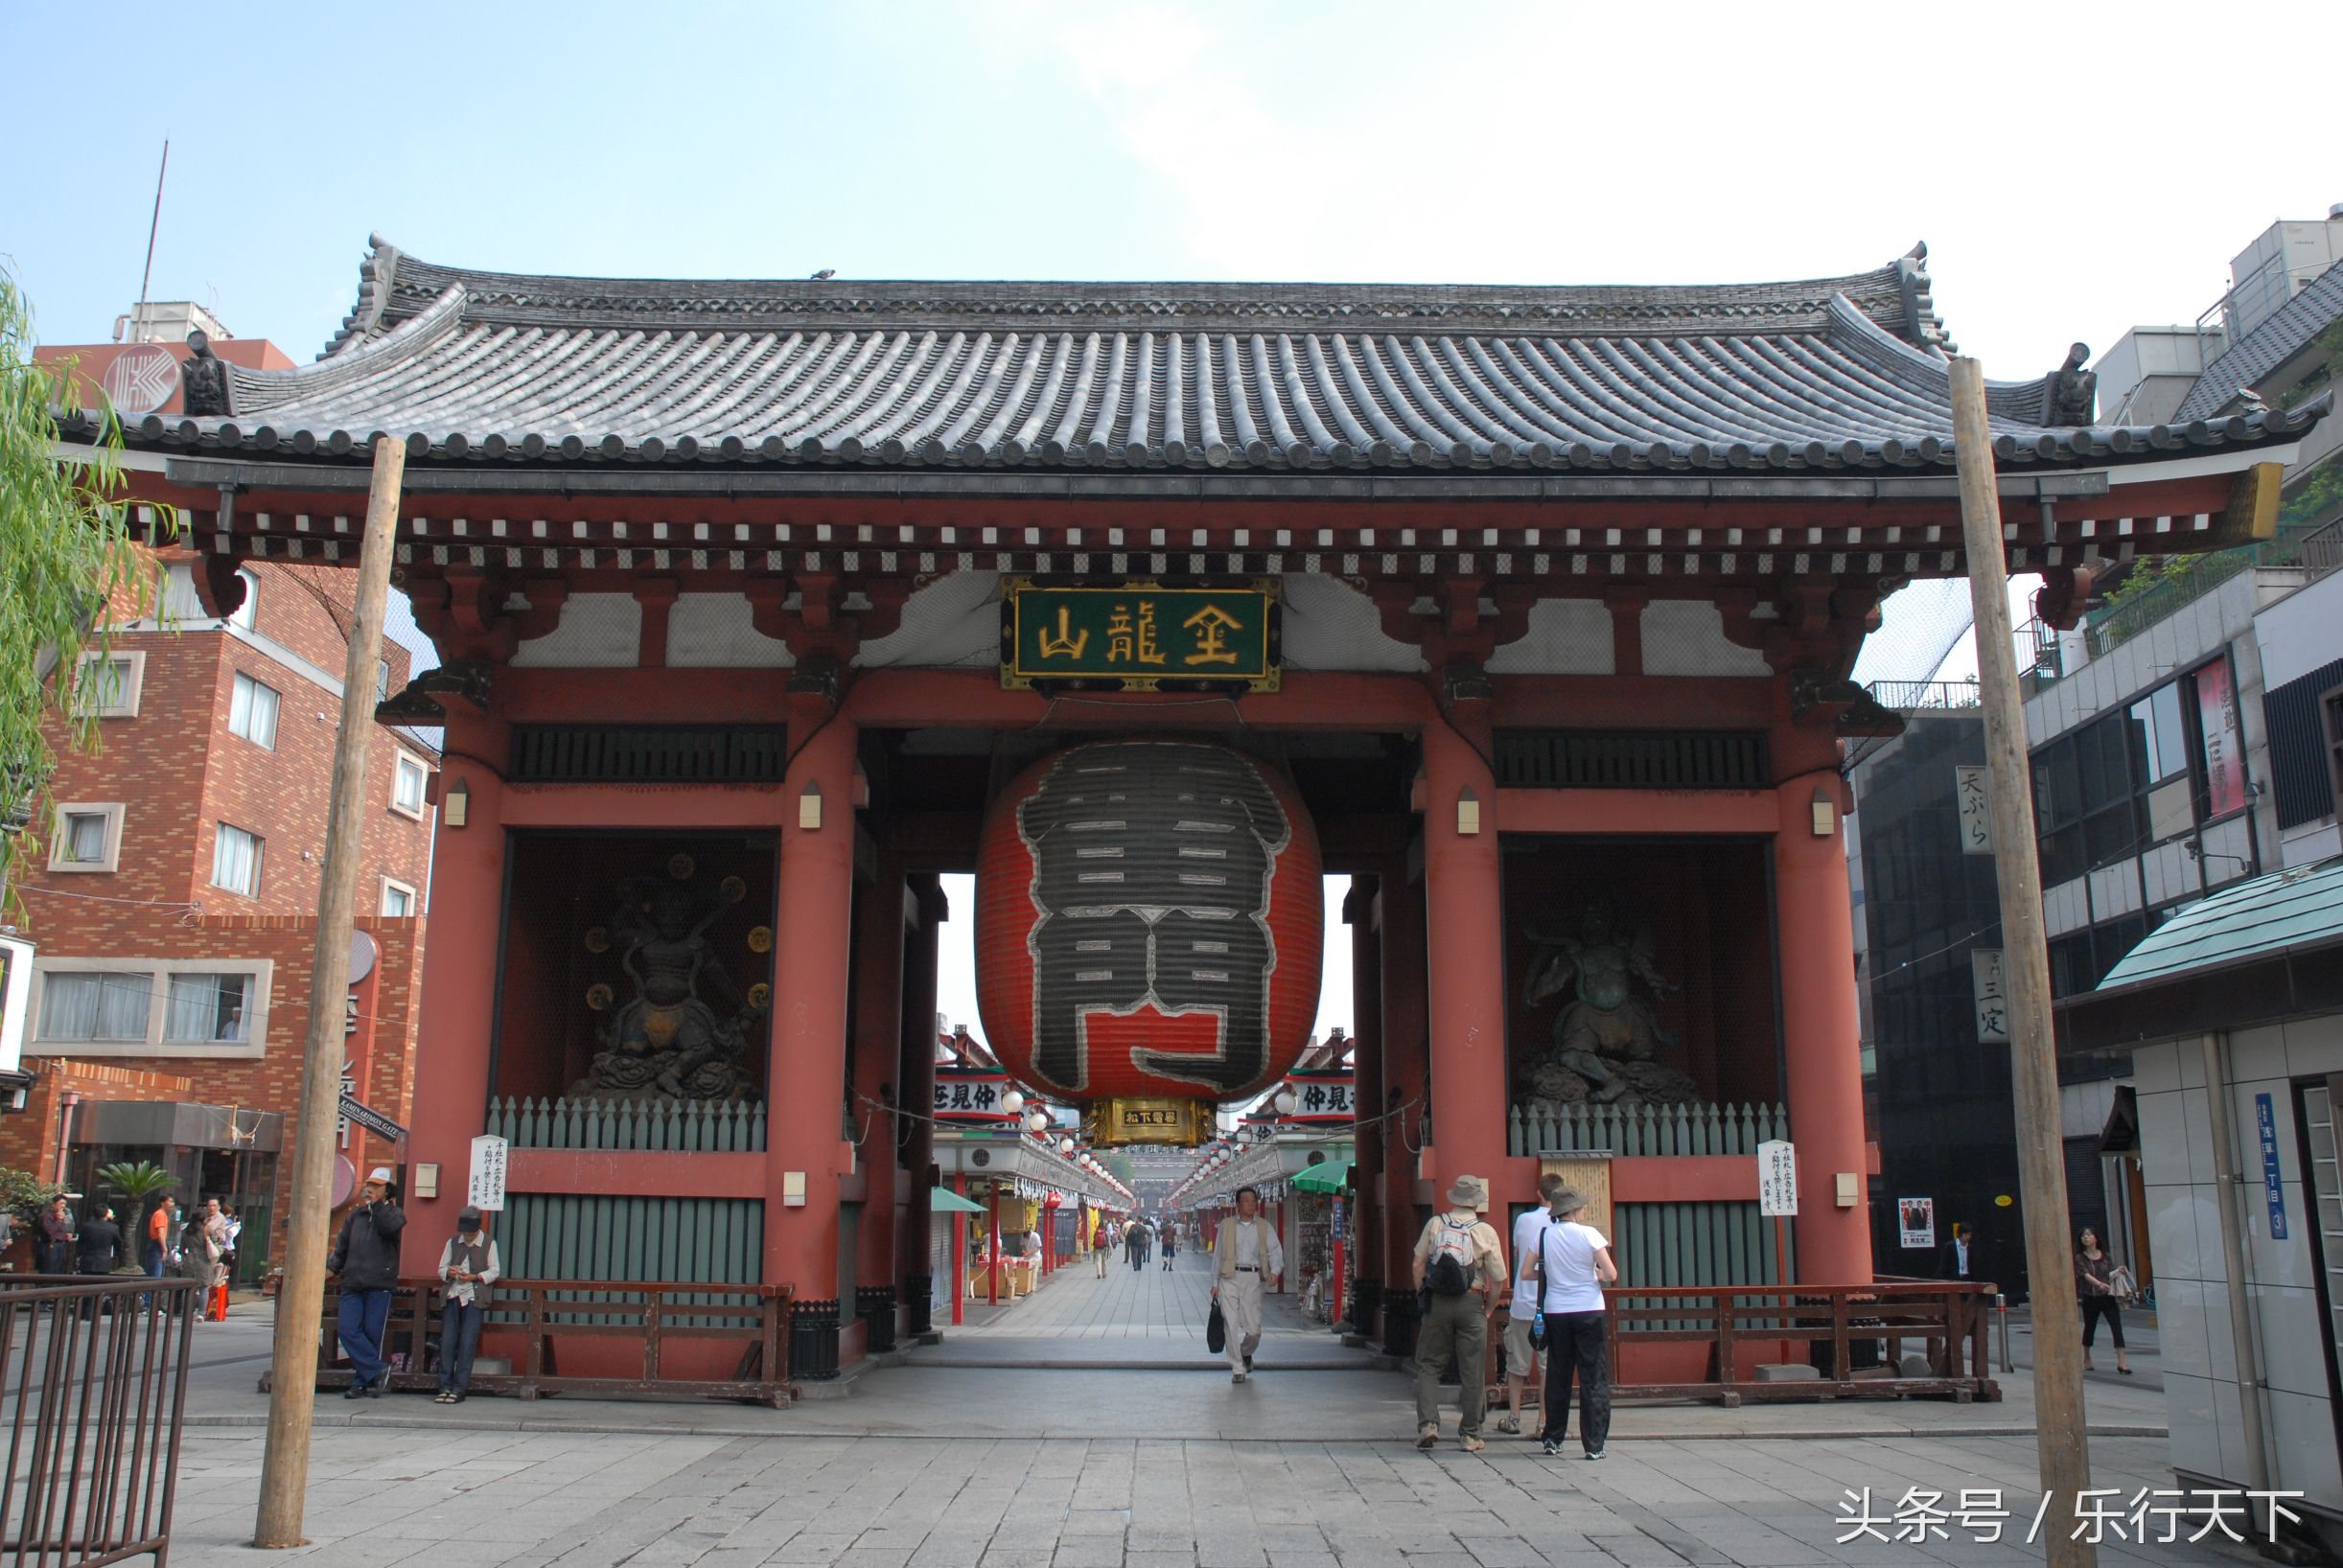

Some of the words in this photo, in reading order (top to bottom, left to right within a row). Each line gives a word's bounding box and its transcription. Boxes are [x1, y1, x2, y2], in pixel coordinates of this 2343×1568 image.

[1038, 600, 1243, 665] 金龍山
[1016, 742, 1292, 1094] 雷門
[1978, 981, 2007, 1035] 三定
[340, 1099, 384, 1127] KAMINARIMON
[382, 1121, 400, 1137] GATE
[1126, 1111, 1176, 1124] 松下電器
[2273, 1214, 2281, 1230] 3
